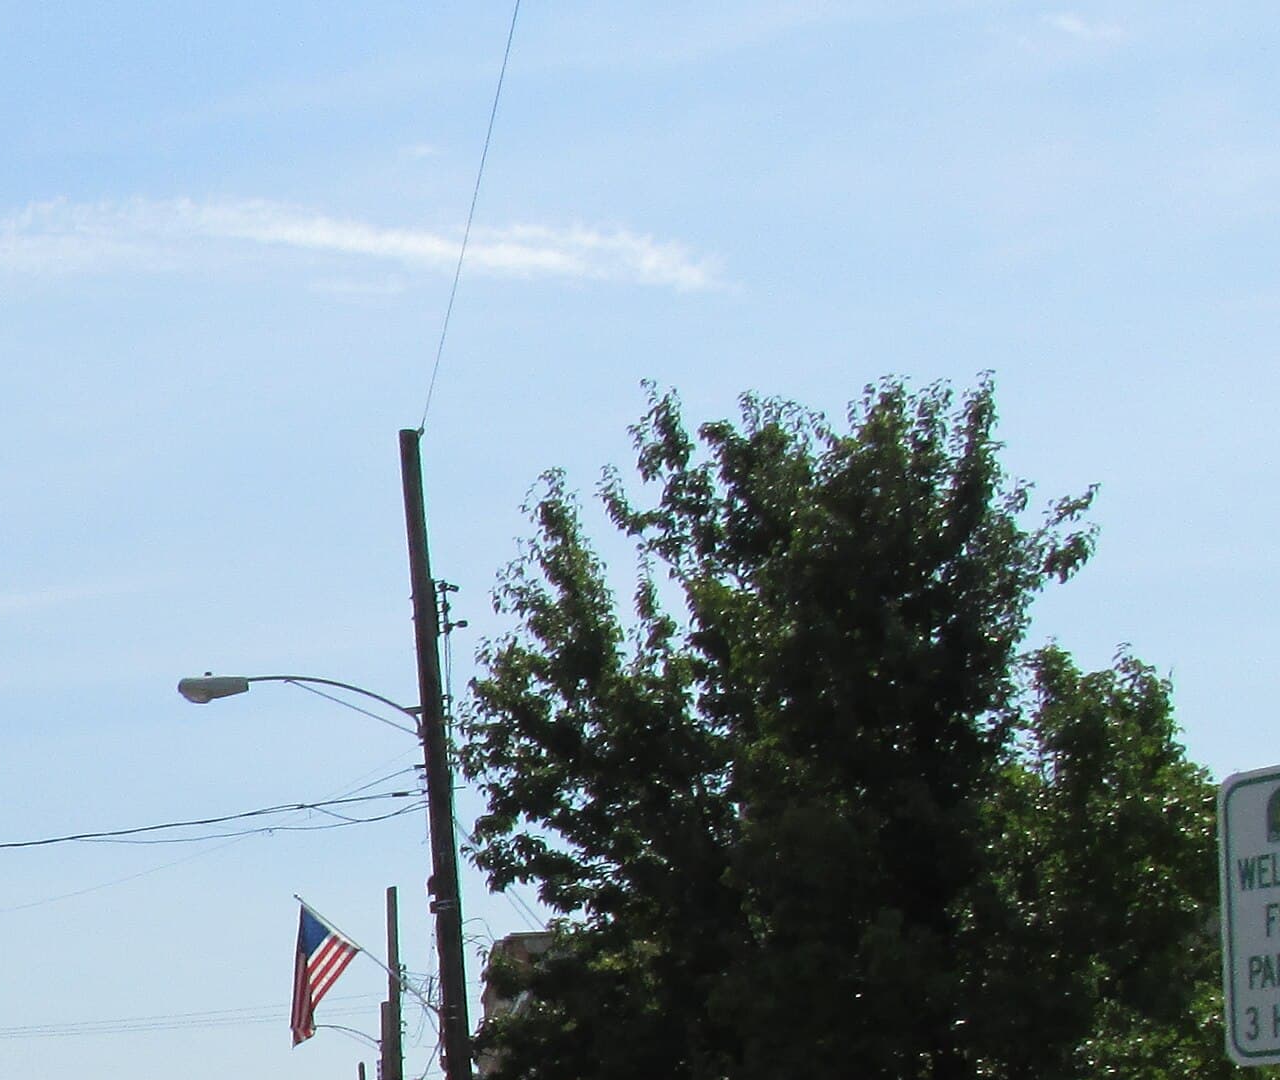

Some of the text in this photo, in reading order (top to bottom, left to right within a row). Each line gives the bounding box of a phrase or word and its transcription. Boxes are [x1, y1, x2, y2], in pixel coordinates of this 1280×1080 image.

[1238, 852, 1280, 891] WEL
[1248, 953, 1280, 990] PA
[1245, 1006, 1260, 1041] 3
